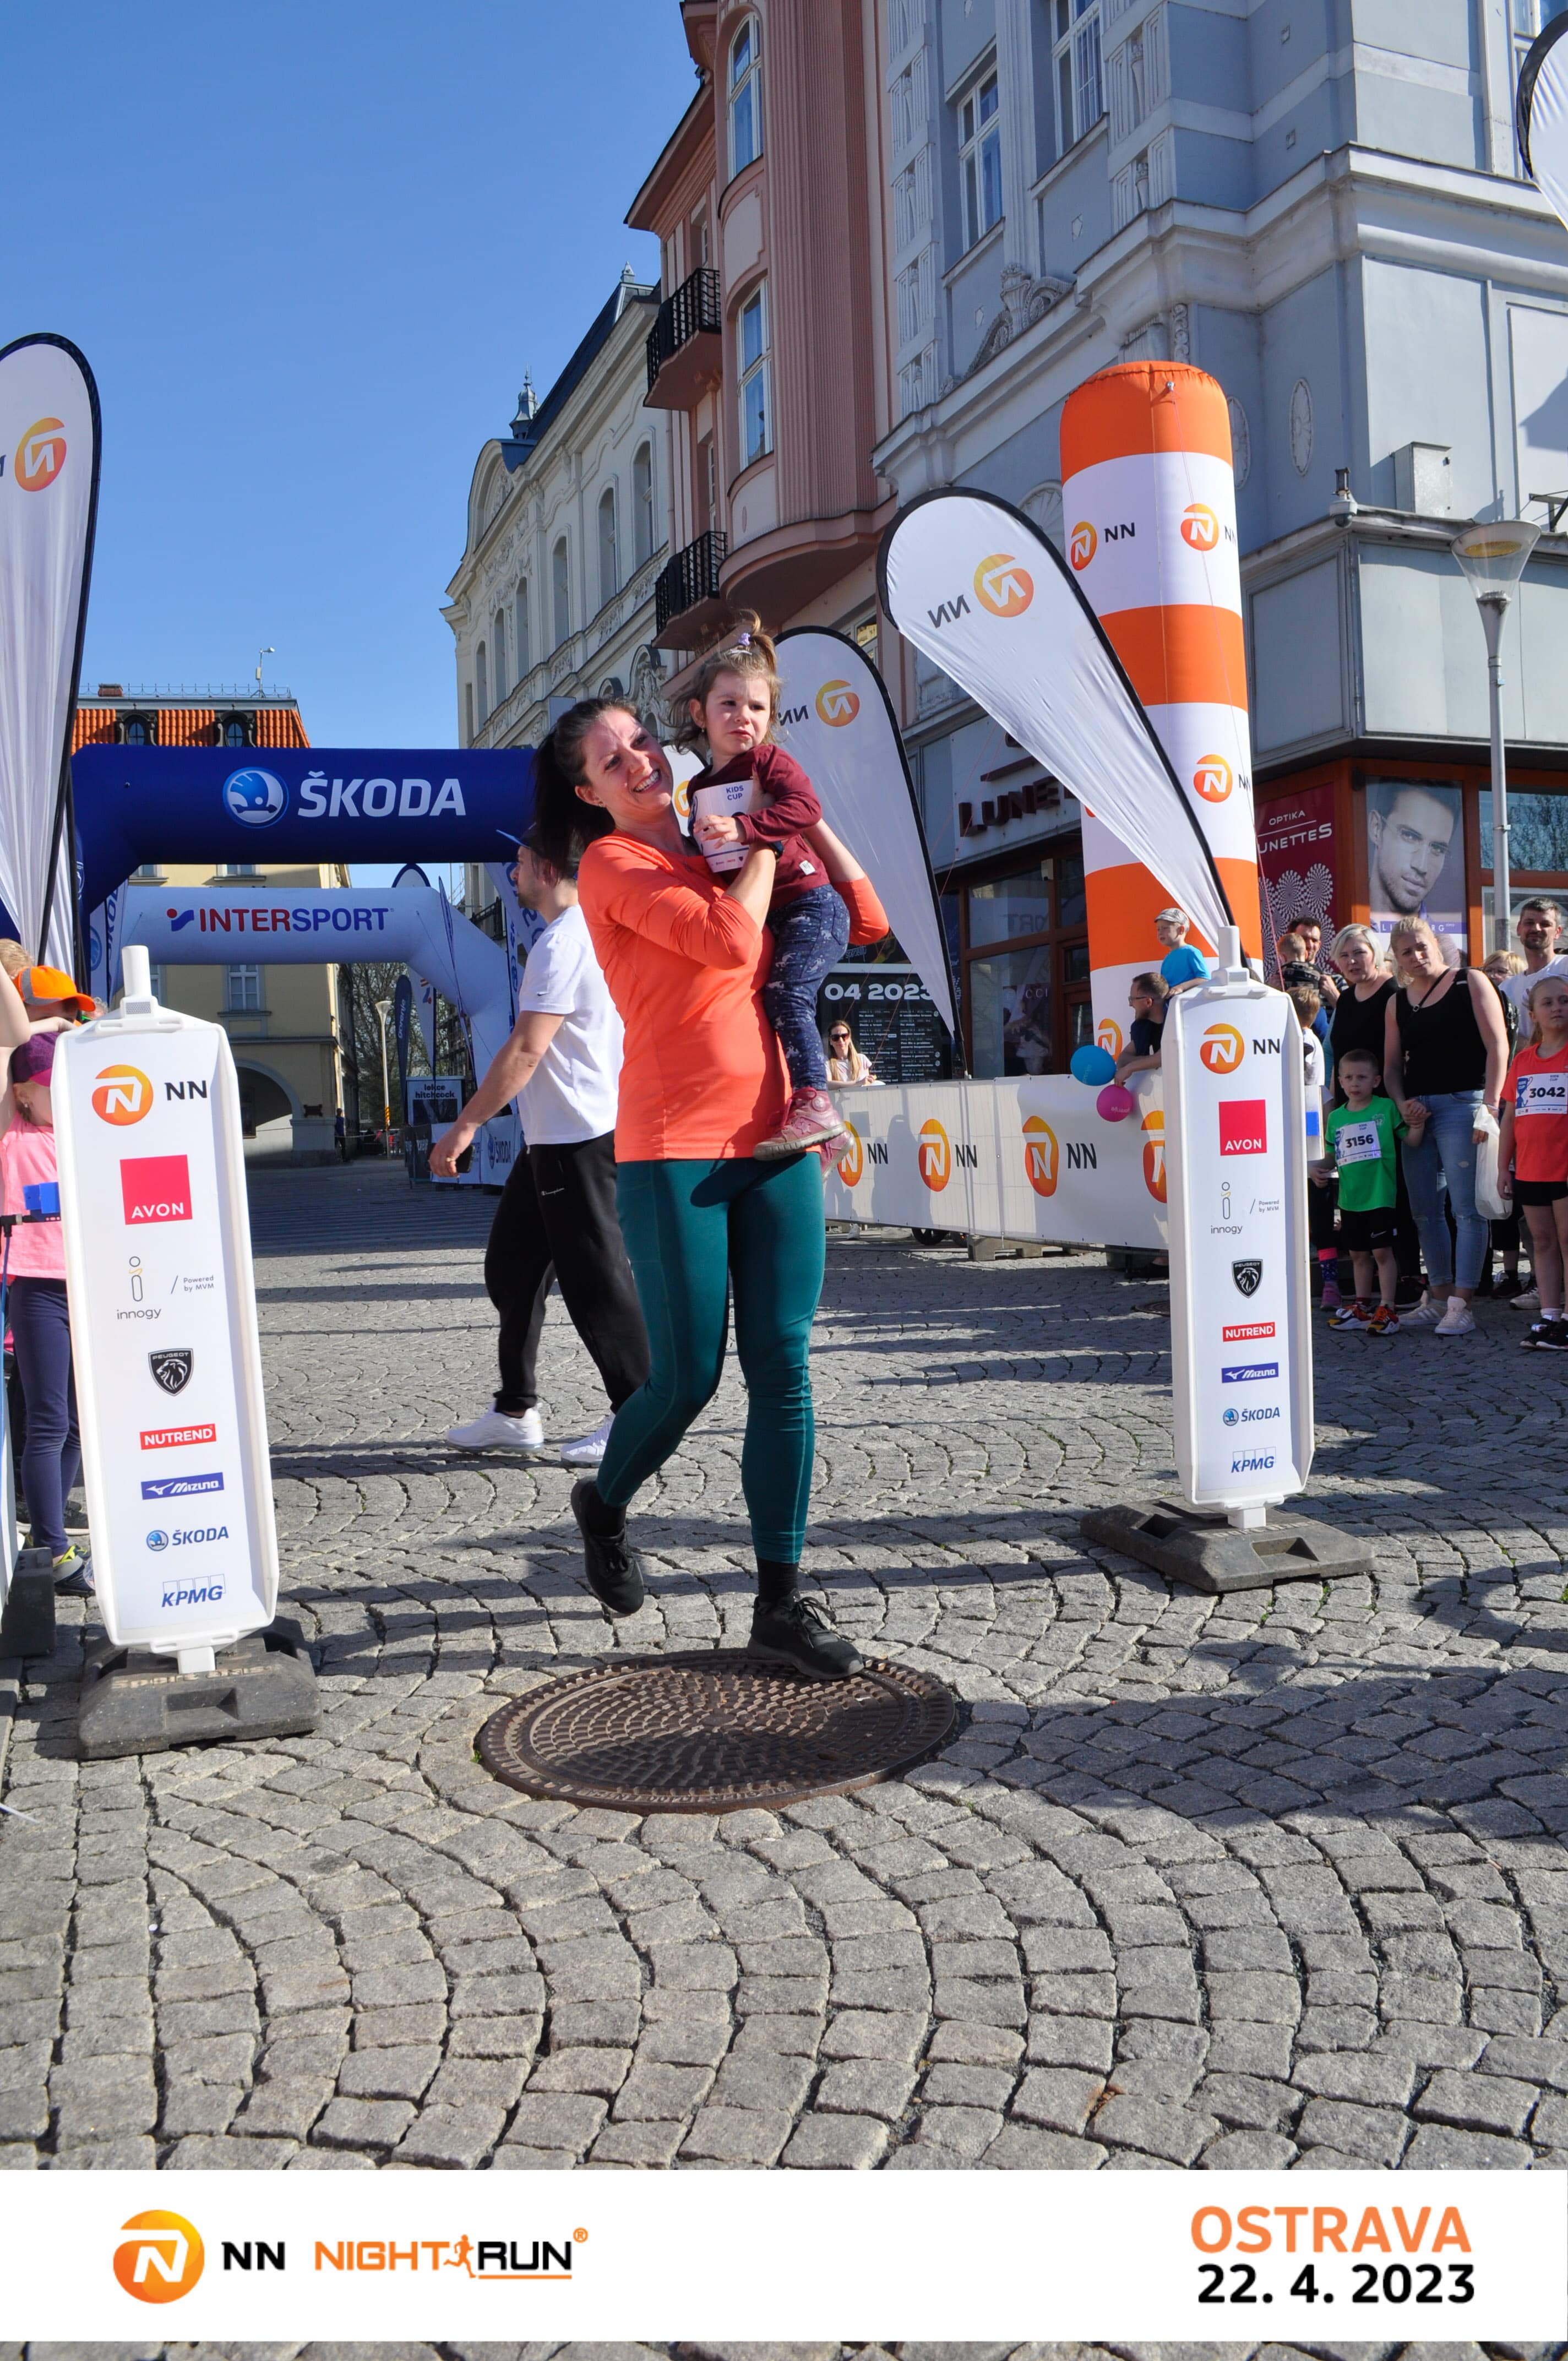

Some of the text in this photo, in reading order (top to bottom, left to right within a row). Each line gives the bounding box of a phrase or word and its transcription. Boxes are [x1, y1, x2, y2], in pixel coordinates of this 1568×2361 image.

[1104, 523, 1135, 543] NN
[298, 771, 466, 817] ŠKODA
[726, 785, 744, 794] KIDS
[727, 792, 743, 801] CUP
[959, 776, 1079, 837] LUNE
[1268, 810, 1305, 825] OPTIKA
[1259, 823, 1332, 854] UNETTES
[199, 908, 389, 932] INTERSPORT
[825, 983, 862, 1000] 04
[1253, 1038, 1281, 1055] NN
[164, 1080, 208, 1101] NN
[1529, 1086, 1565, 1098] 3042
[1225, 1138, 1262, 1151] AVON
[1346, 1134, 1374, 1149] 3156
[867, 1143, 889, 1164] NN
[955, 1145, 978, 1168] NN
[1066, 1143, 1097, 1169] NN
[132, 1203, 184, 1218] AVON
[1211, 1225, 1243, 1234] innogy
[183, 1275, 214, 1283] Powered
[117, 1308, 161, 1320] innogy
[1226, 1325, 1273, 1339] NUTREND
[152, 1352, 189, 1360] PEUGEOT
[1241, 1407, 1281, 1422] ŠKODA
[144, 1428, 213, 1446] NUTREND
[1231, 1456, 1275, 1473] KPMG
[172, 1526, 229, 1546] ŠKODA
[161, 1585, 224, 1608] KPMG
